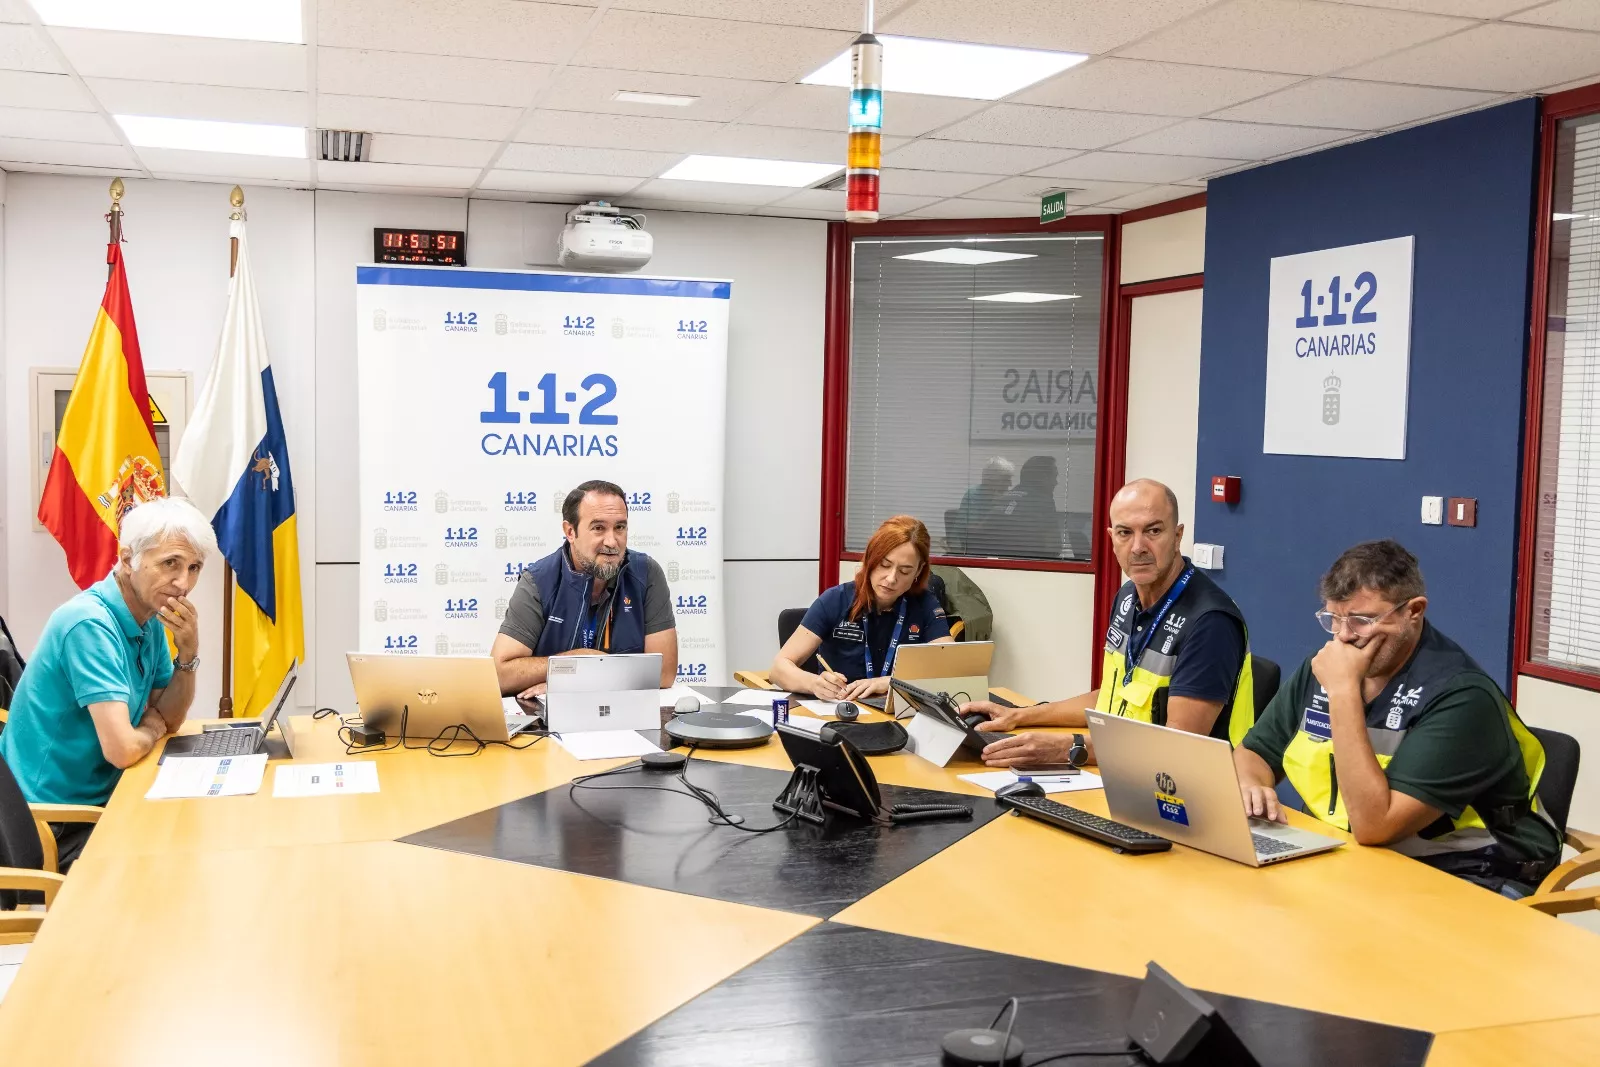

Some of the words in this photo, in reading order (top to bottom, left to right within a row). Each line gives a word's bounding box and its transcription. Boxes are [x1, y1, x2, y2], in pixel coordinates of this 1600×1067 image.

[1043, 200, 1064, 216] SALIDA
[1295, 332, 1376, 358] CANARIAS
[481, 433, 618, 457] CANARIAS
[1157, 772, 1176, 795] hp
